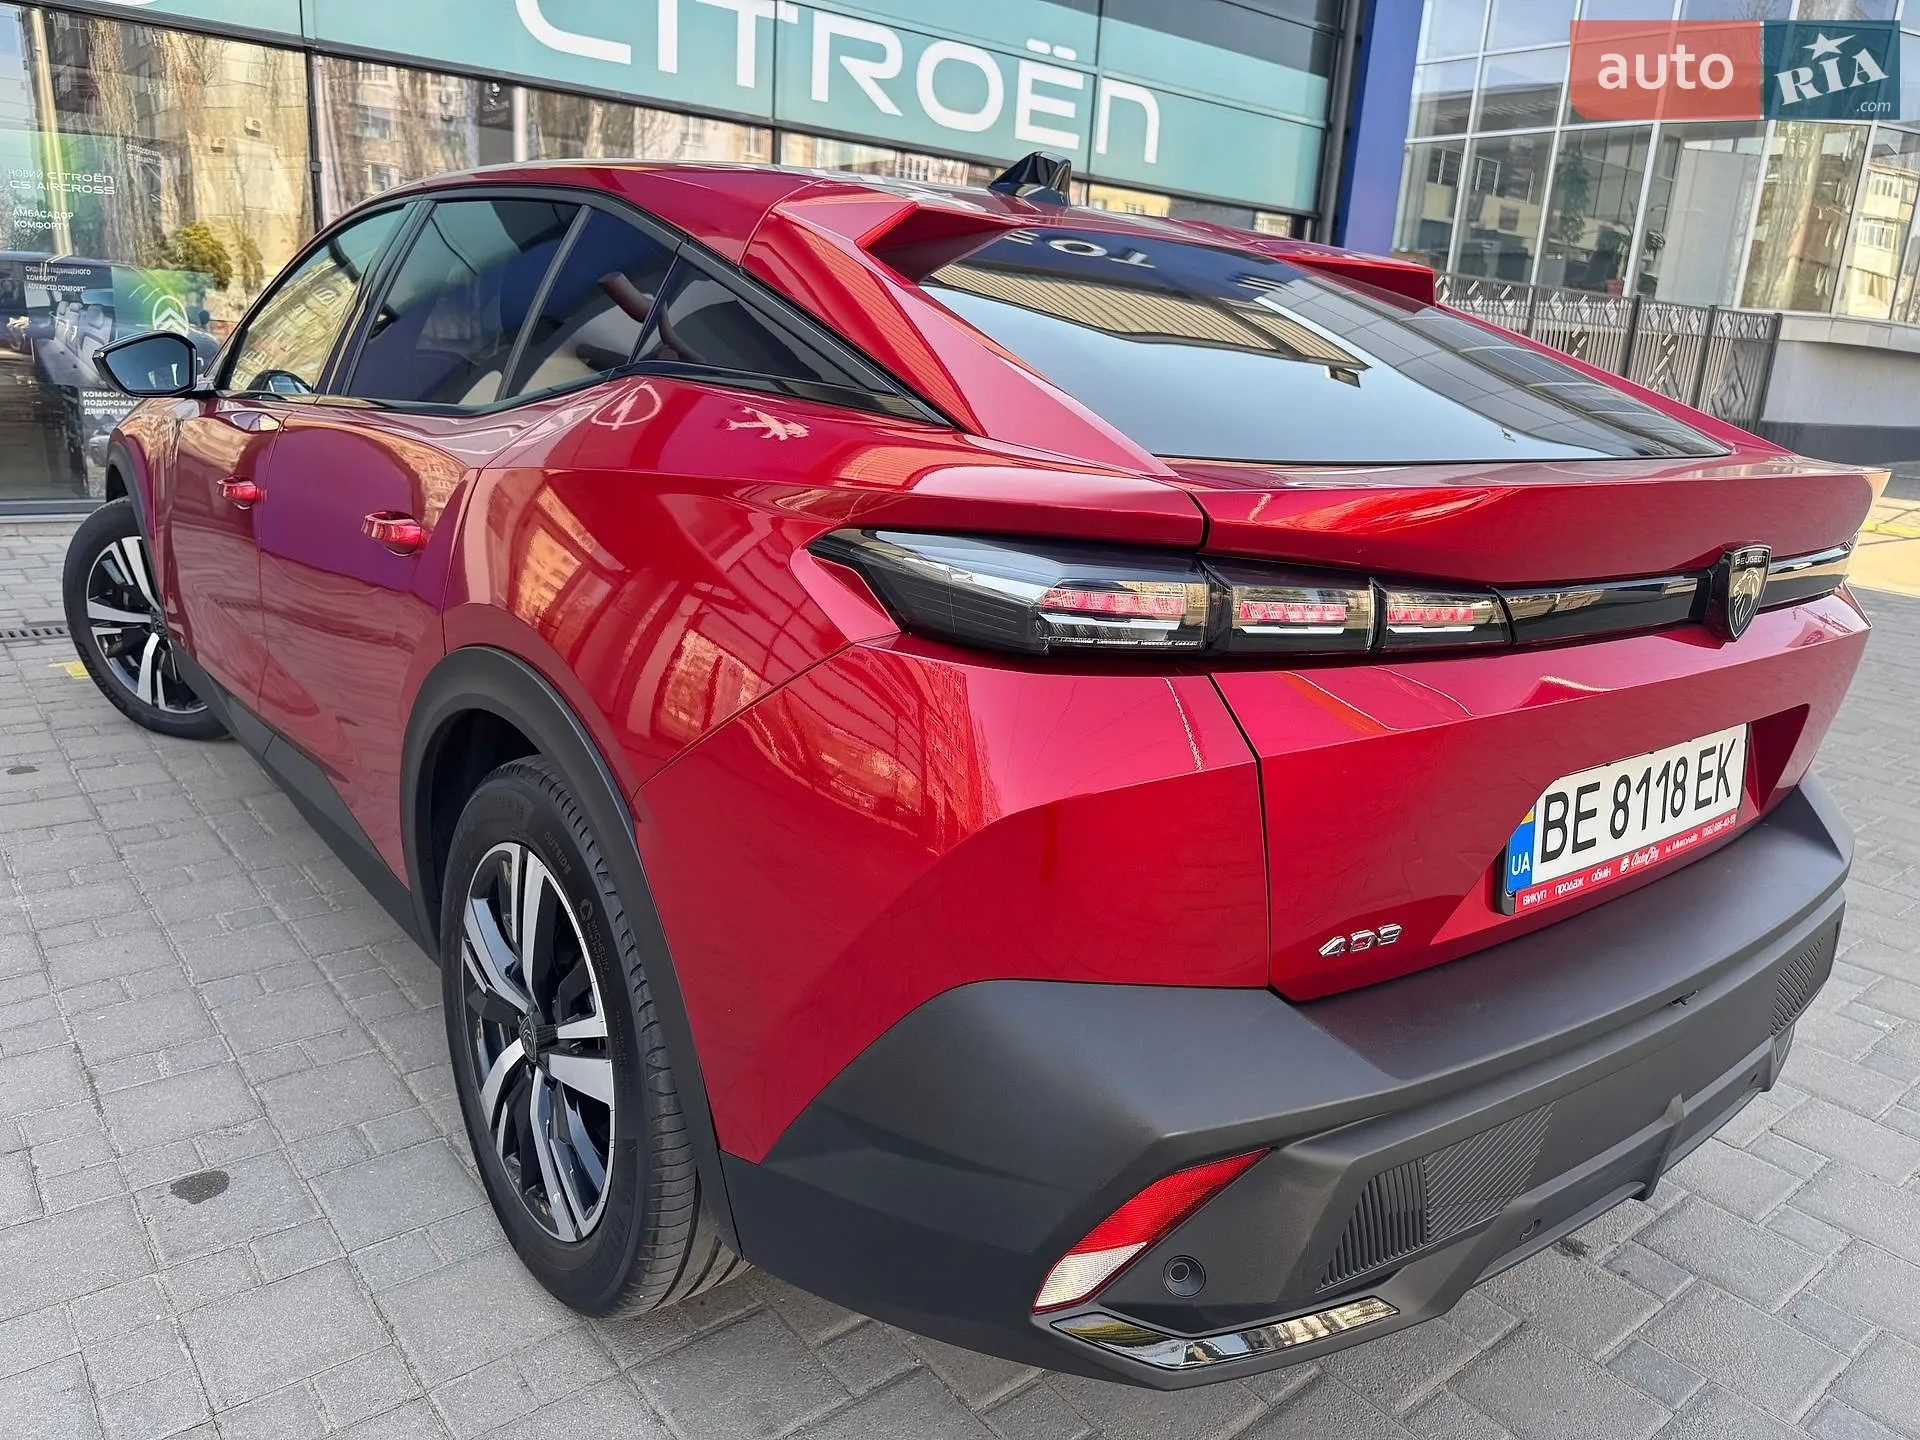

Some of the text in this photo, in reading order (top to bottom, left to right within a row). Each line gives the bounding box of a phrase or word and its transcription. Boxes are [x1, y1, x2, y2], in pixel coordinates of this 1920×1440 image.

[8, 168, 43, 178] НОВИЙ
[36, 182, 115, 195] AIRCROSS
[13, 208, 74, 220] АМБАСАДОР
[14, 220, 69, 231] КОМФОРТУ
[1735, 555, 1767, 566] PEUGEOT
[1540, 737, 1737, 864] BE 8118 EK
[1511, 851, 1531, 876] UA
[1522, 889, 1547, 906] викуп
[1554, 876, 1585, 897] продаж
[1590, 865, 1613, 883] обмін
